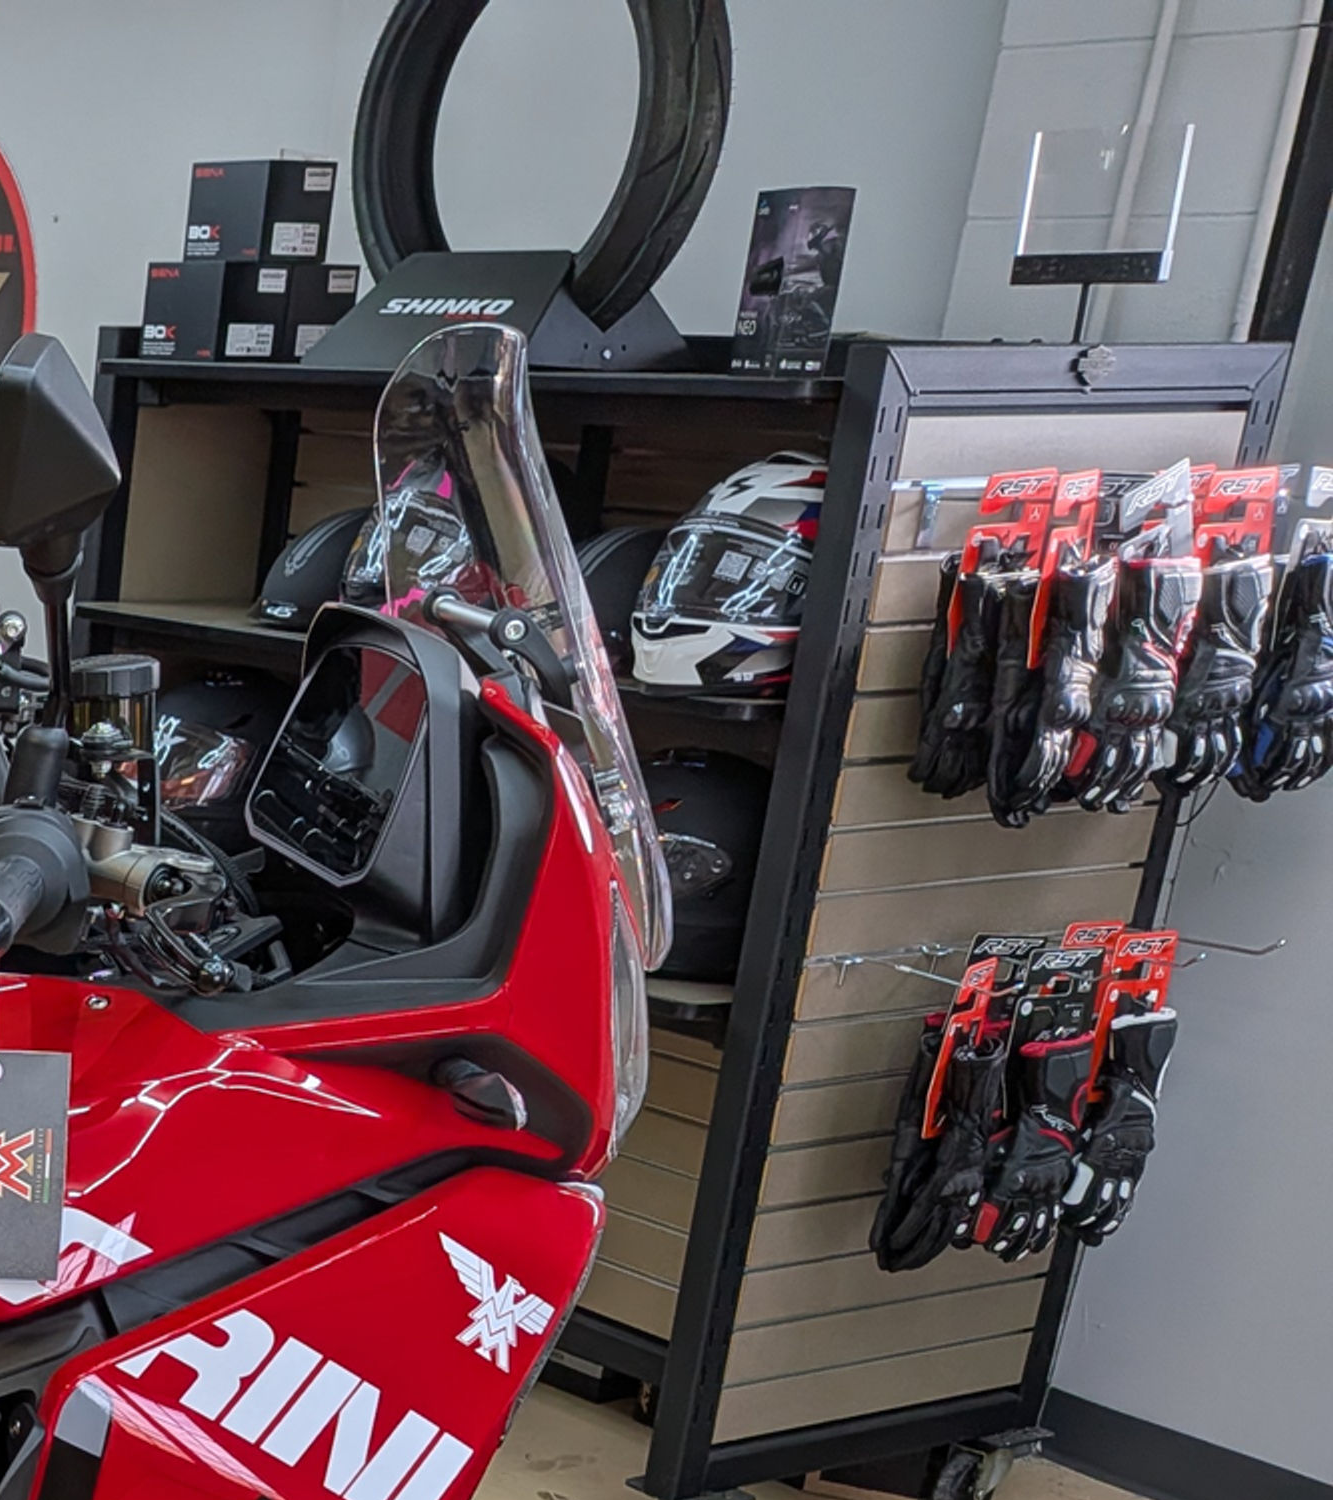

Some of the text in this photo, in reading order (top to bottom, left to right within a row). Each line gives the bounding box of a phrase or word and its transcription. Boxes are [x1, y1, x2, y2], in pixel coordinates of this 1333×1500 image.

[378, 297, 515, 316] SHINKO
[987, 475, 1059, 499] RST
[1062, 475, 1098, 499] RST
[1209, 475, 1273, 498] RST
[973, 937, 1047, 955] RST
[1065, 926, 1119, 945] RST
[1118, 937, 1176, 957] RST
[1031, 950, 1104, 972] RST
